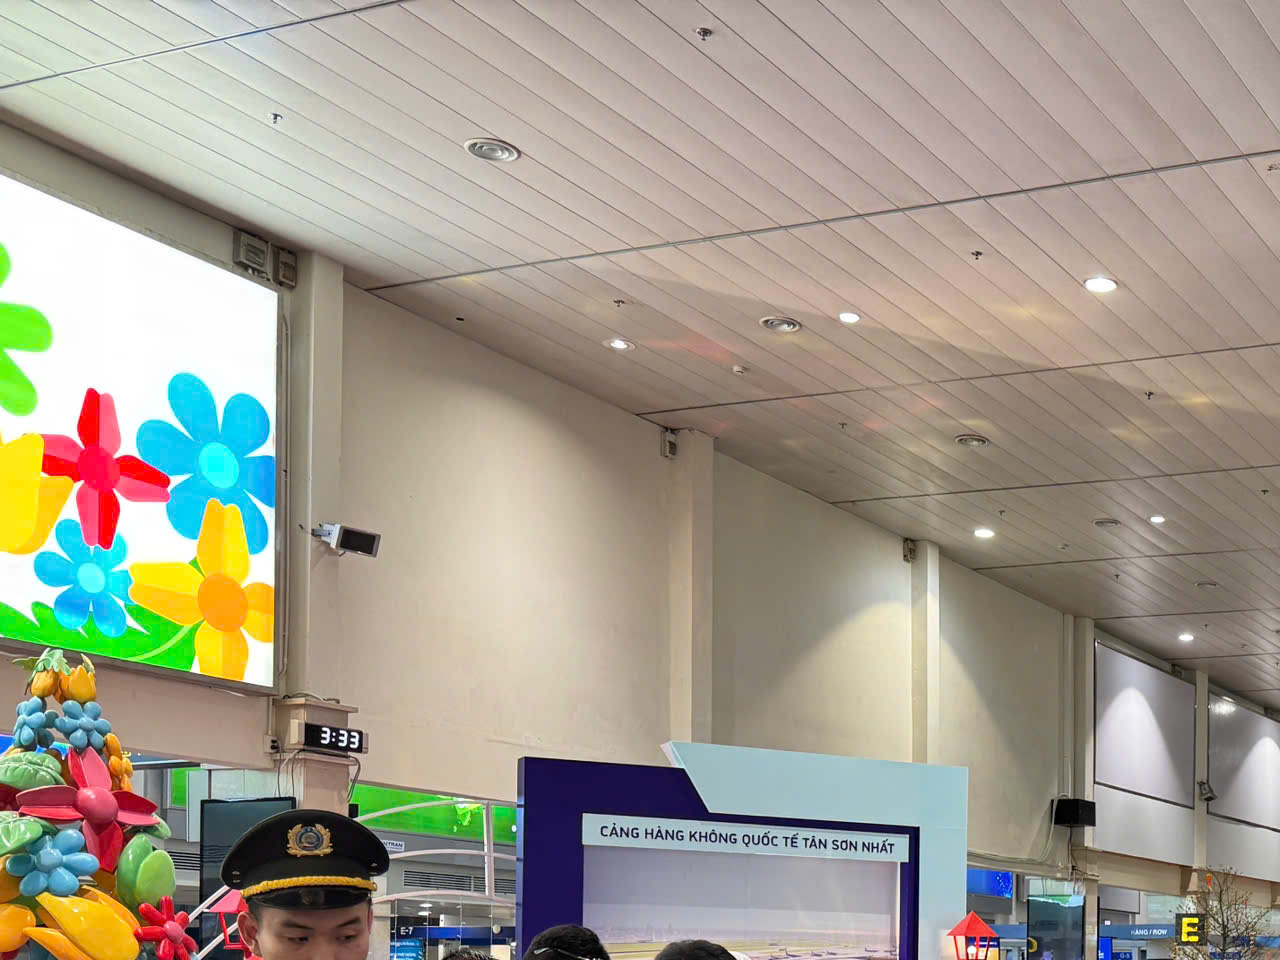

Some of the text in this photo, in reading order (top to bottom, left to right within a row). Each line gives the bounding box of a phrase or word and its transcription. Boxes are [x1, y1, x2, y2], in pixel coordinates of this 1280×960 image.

[320, 727, 360, 749] 3:33
[600, 823, 895, 854] CẢNG HÀNG KHÔNG QUỐC TẾ TÂN SƠN NHẤT
[1152, 928, 1168, 936] ROW
[1181, 917, 1199, 942] E
